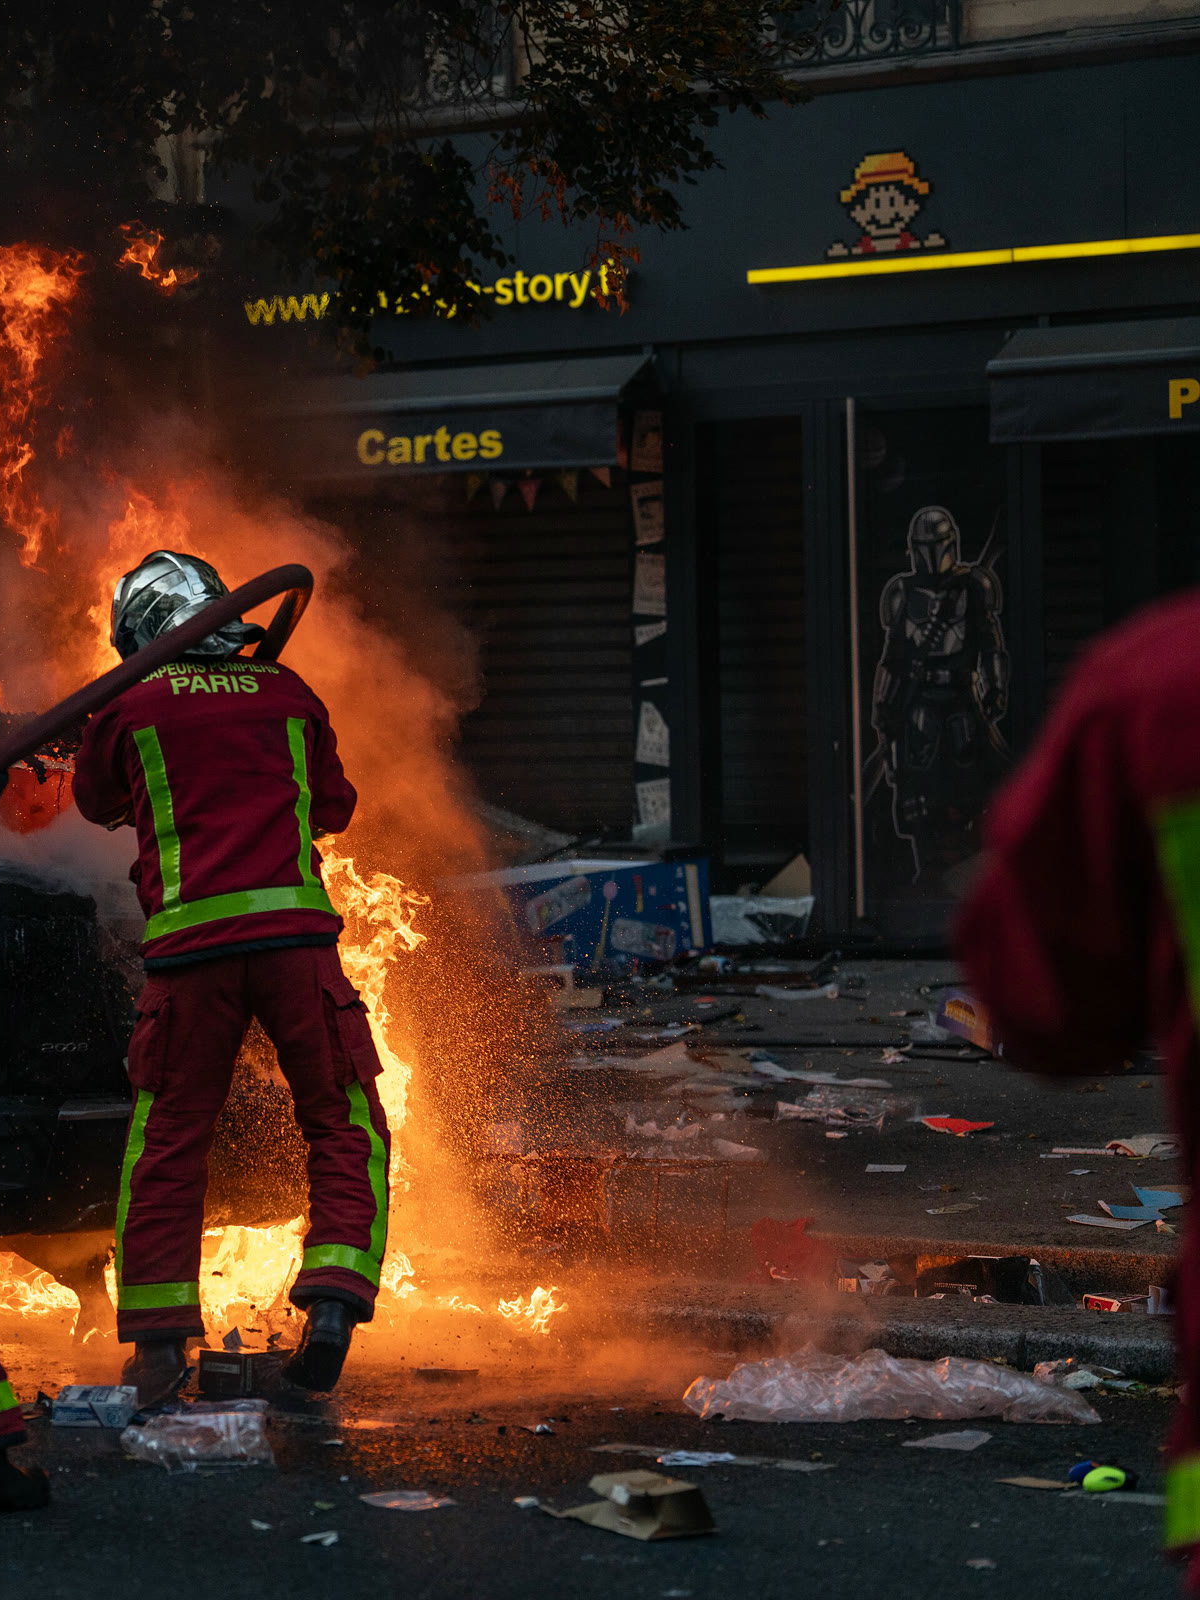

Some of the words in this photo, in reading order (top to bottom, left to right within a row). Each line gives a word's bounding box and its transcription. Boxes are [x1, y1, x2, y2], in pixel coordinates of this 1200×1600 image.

[1169, 378, 1200, 419] P
[357, 425, 504, 466] Cartes
[170, 675, 260, 695] PARIS
[41, 1041, 88, 1052] 2008
